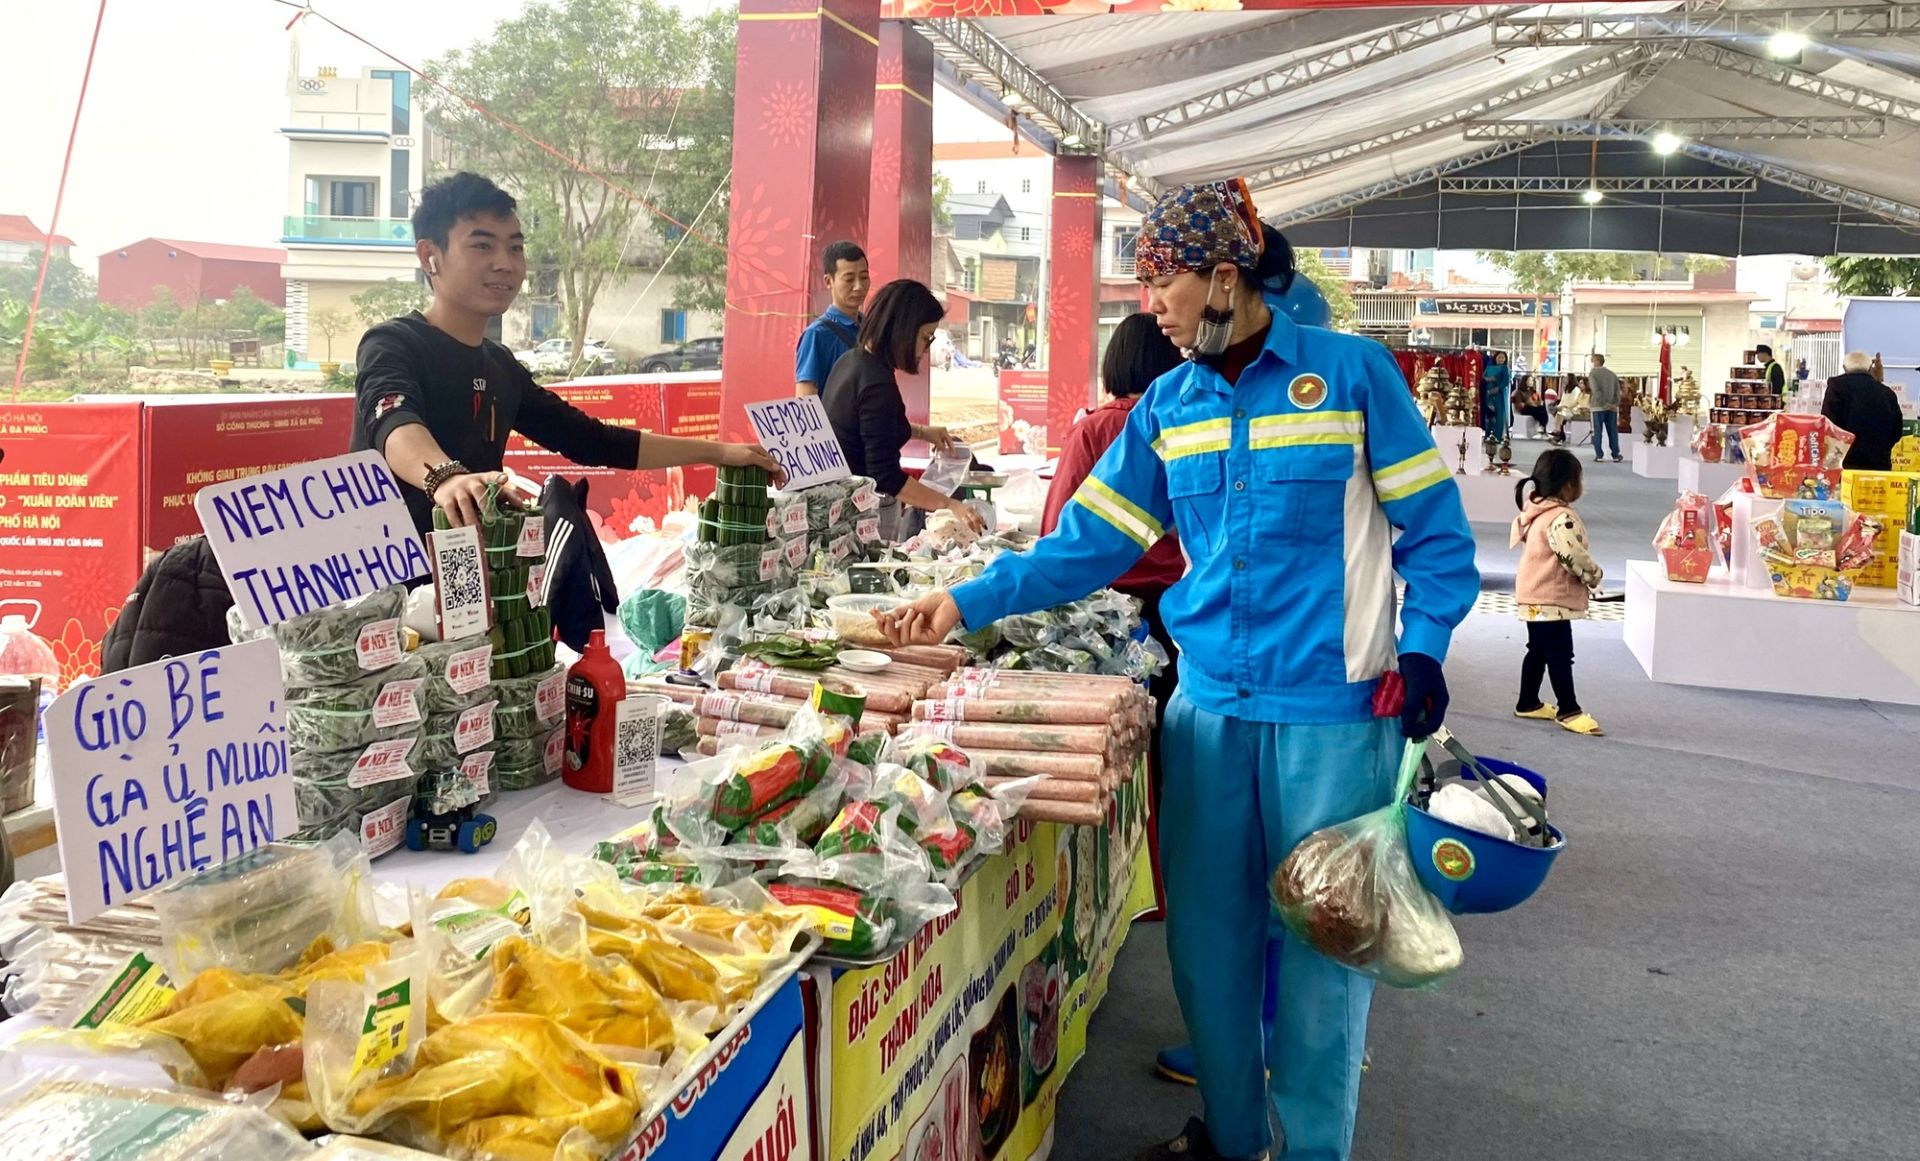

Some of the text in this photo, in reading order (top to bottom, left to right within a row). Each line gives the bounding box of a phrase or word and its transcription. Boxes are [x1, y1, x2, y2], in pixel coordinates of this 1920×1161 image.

[33, 472, 55, 486] TIÊU
[58, 472, 88, 487] DÙNG
[186, 469, 215, 484] KHÔNG
[216, 468, 235, 481] GIAN
[55, 493, 85, 508] ĐOÀN
[212, 462, 400, 542] NEM CHUA
[23, 515, 38, 529] HÀ
[41, 514, 61, 531] NỘI
[371, 634, 388, 650] NEM
[459, 658, 475, 675] NEM
[164, 650, 224, 739] BÊ
[567, 682, 594, 699] CHIN-SU
[86, 754, 148, 827] GÀ
[163, 743, 196, 803] Ủ
[98, 794, 275, 905] NGHỆ AN
[848, 980, 880, 1045] ĐẶC
[880, 993, 920, 1075] THANH
